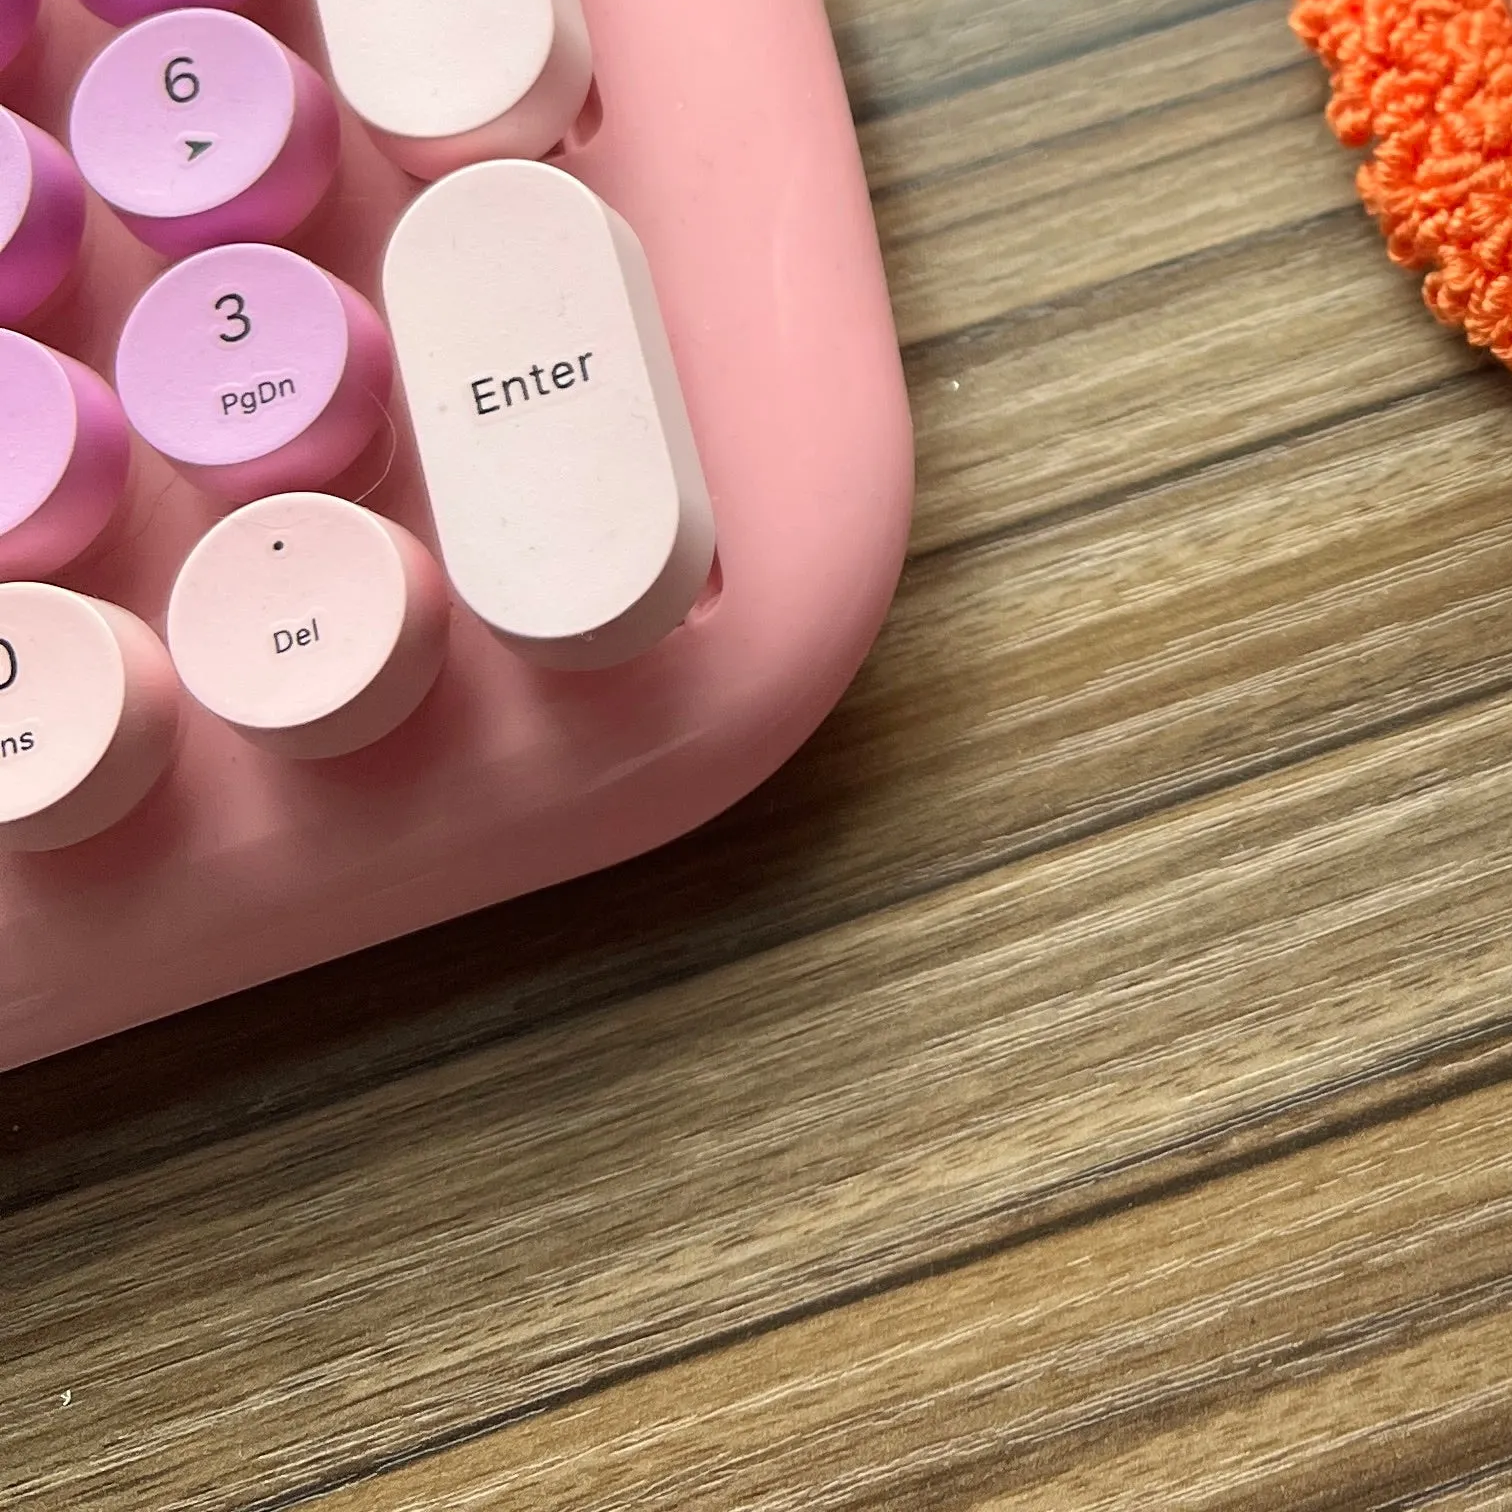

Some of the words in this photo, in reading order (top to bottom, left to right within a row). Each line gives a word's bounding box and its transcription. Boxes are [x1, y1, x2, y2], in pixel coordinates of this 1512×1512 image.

[163, 56, 200, 104] 6
[213, 292, 252, 343] 3
[220, 376, 296, 416] PgDn
[470, 350, 594, 416] Enter
[273, 618, 320, 655] Del
[0, 731, 35, 758] ns
